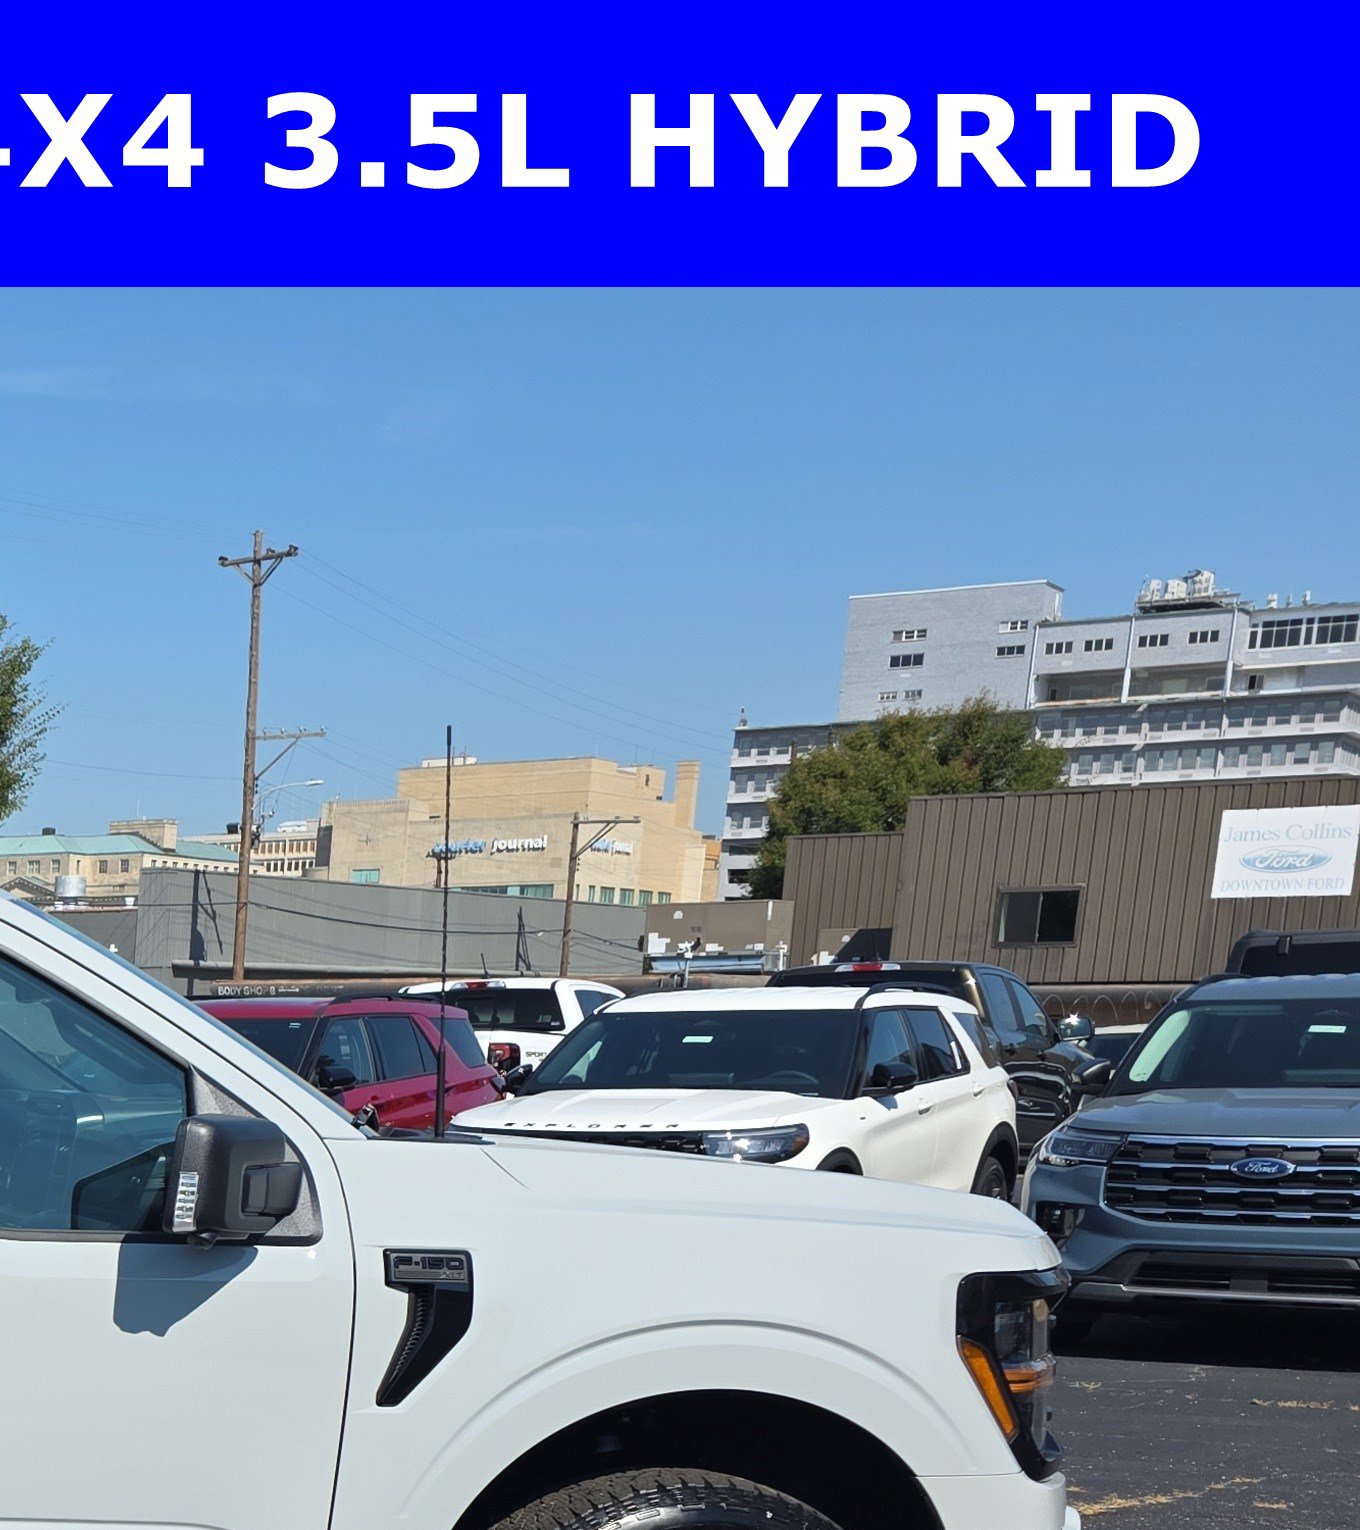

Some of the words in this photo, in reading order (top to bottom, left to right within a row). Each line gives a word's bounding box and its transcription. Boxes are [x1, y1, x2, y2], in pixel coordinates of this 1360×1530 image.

[1224, 826, 1280, 843] James
[1285, 822, 1352, 841] Collins
[490, 835, 548, 853] journal
[1220, 878, 1302, 893] DOWNTOWN
[1307, 877, 1345, 891] FORD
[218, 985, 242, 996] BODY
[393, 1255, 466, 1271] F-150
